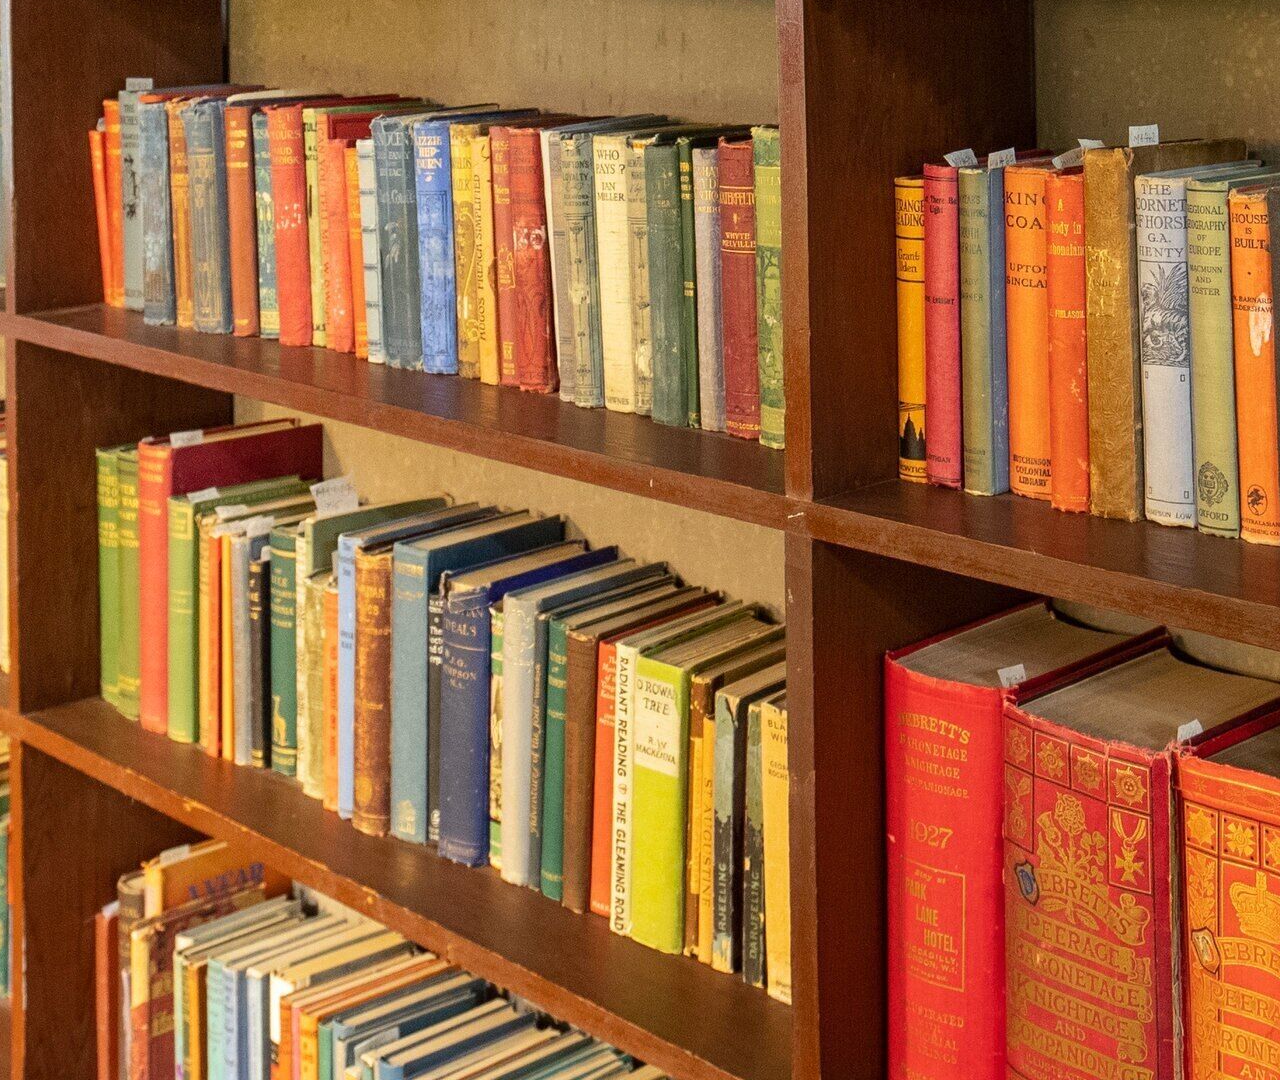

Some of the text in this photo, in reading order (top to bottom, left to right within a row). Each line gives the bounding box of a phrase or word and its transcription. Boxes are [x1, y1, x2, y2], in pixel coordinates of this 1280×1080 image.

[597, 149, 620, 160] WHO
[601, 181, 616, 192] IAN
[1140, 183, 1172, 196] THE
[597, 191, 626, 203] MILLER
[1231, 213, 1268, 226] HOUSE
[642, 696, 670, 716] TREE
[616, 655, 629, 778] RADIANT READING
[614, 801, 626, 933] THE GLEAMING ROAD
[748, 871, 759, 961] DARJEELING
